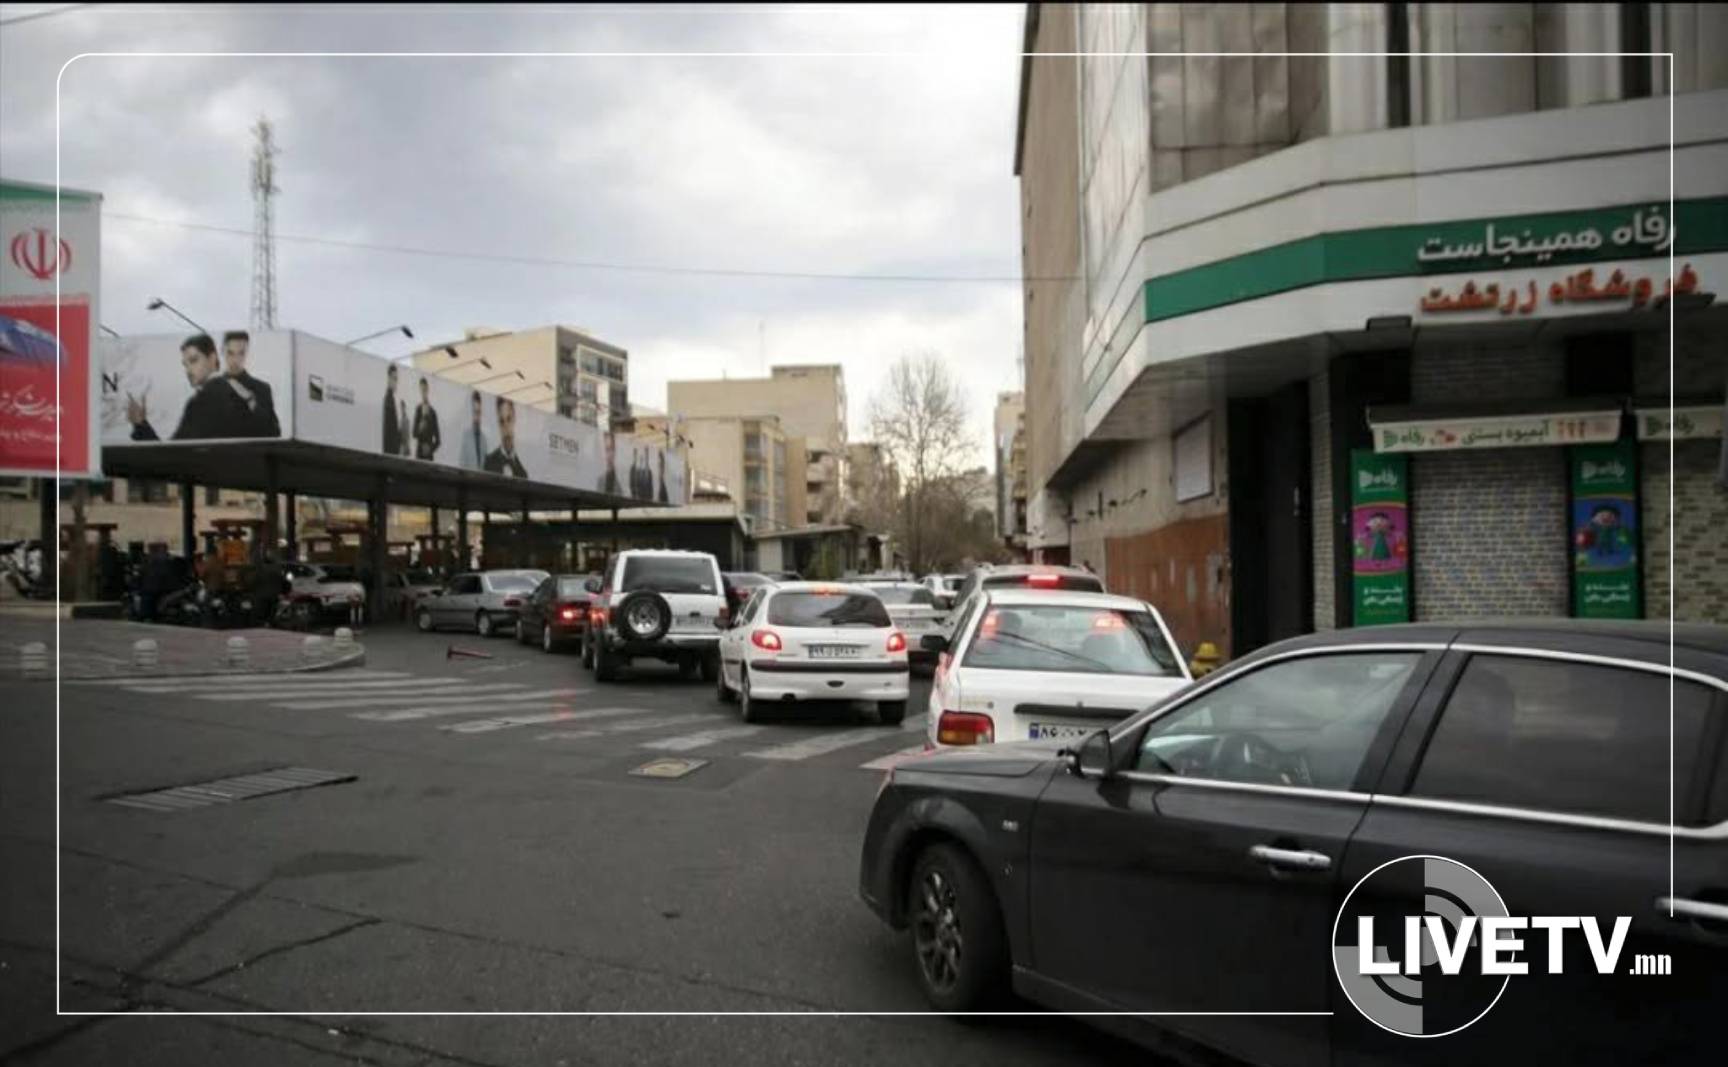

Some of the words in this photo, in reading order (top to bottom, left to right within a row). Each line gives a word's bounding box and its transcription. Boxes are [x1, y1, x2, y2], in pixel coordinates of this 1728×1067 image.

[1417, 223, 1602, 263] همینجاست
[1611, 207, 1677, 251] رفاه
[1420, 279, 1538, 315] زرتشت
